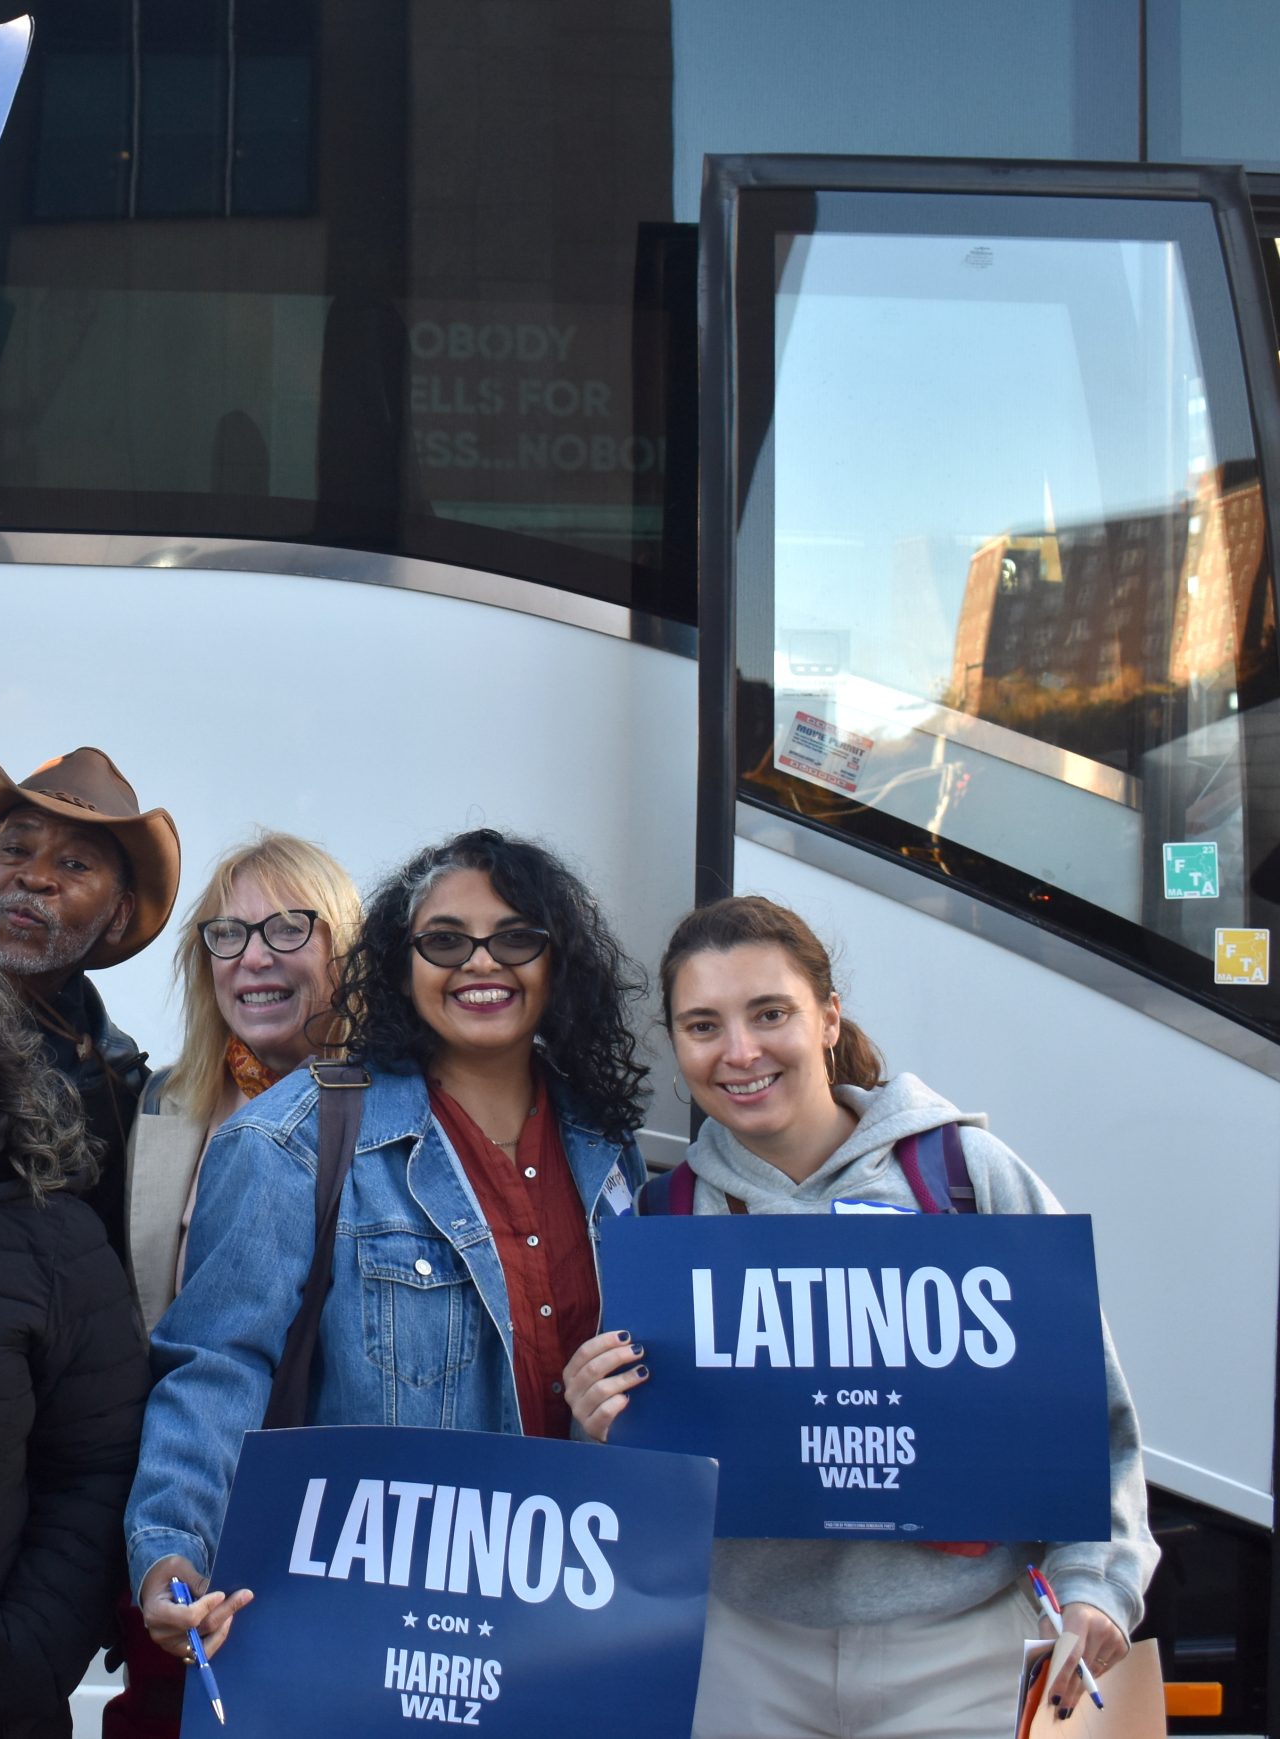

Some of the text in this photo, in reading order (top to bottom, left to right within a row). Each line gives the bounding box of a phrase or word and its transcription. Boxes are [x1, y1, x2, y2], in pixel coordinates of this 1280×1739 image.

[520, 380, 612, 416] FOR
[1202, 846, 1214, 854] 23
[1167, 848, 1216, 895] IFTA
[1168, 888, 1183, 896] MA
[1219, 932, 1265, 981] IFTA
[1217, 974, 1233, 982] MA
[692, 1266, 1016, 1368] LATINOS
[836, 1390, 878, 1405] CON
[800, 1425, 916, 1465] HARRIS
[819, 1467, 900, 1489] WALZ
[288, 1478, 619, 1610] LATINOS
[427, 1613, 469, 1634] CON
[384, 1647, 502, 1701] HARRIS
[400, 1693, 482, 1725] WALZ
